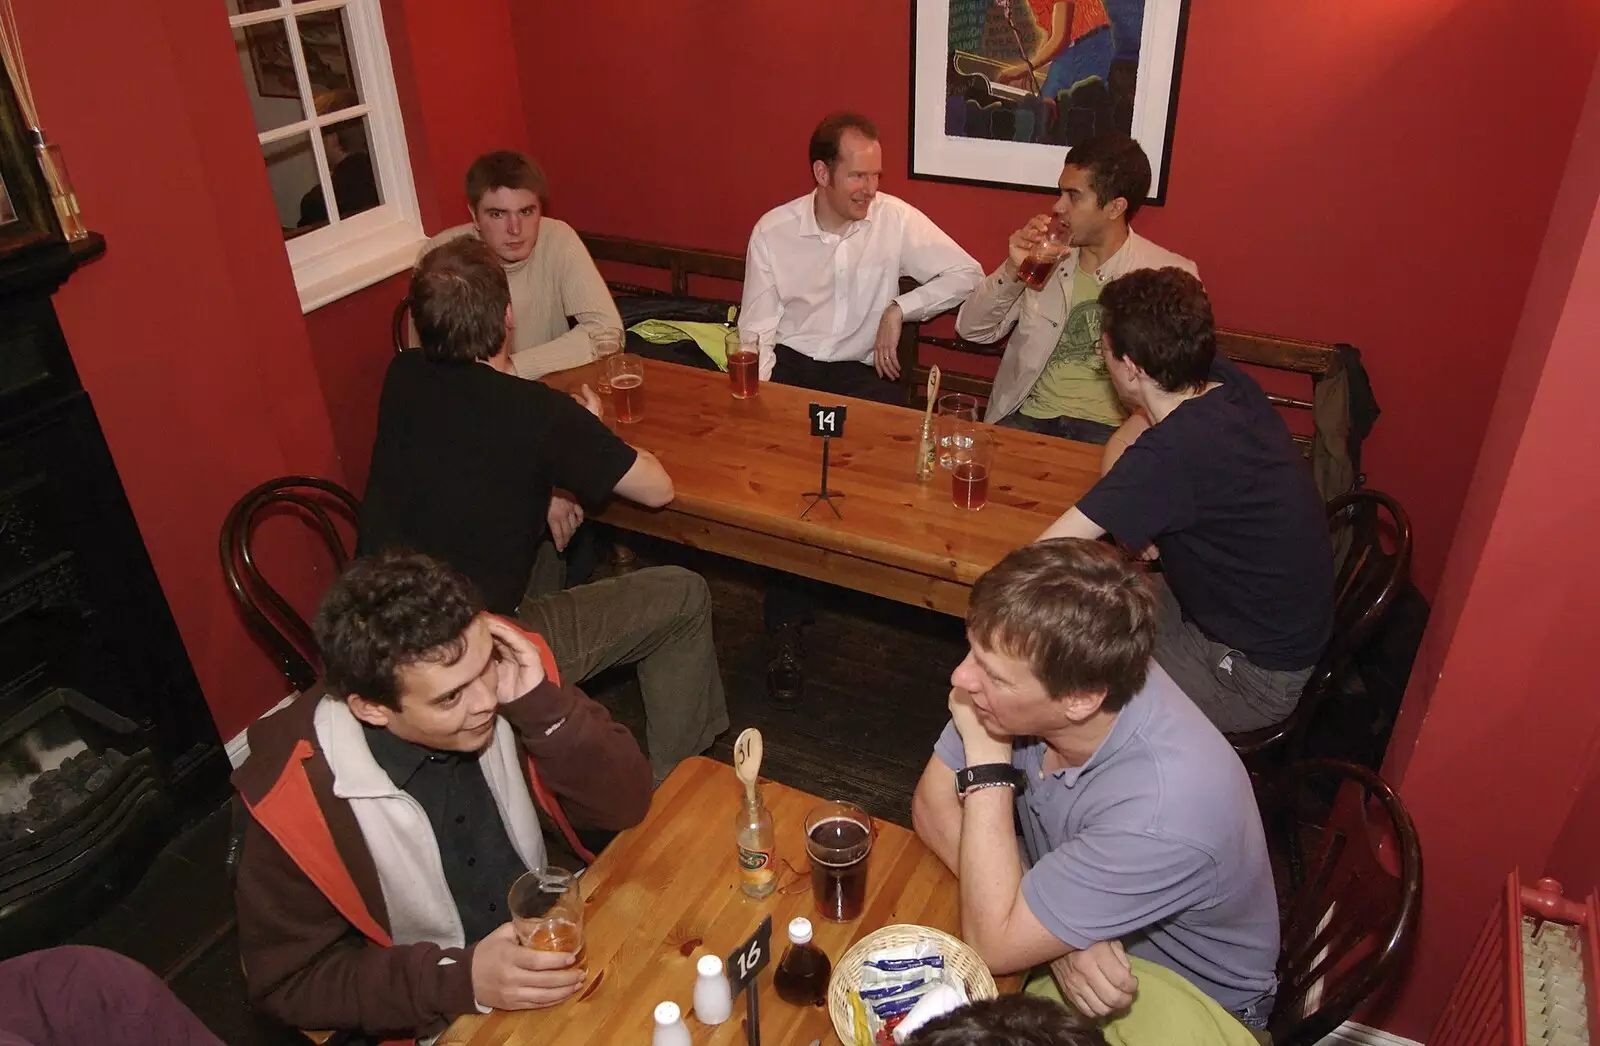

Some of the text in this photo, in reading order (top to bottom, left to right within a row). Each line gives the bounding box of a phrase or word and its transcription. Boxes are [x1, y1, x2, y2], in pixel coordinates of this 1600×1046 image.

[816, 410, 836, 432] 14
[738, 737, 752, 766] 31
[737, 940, 761, 980] 16
